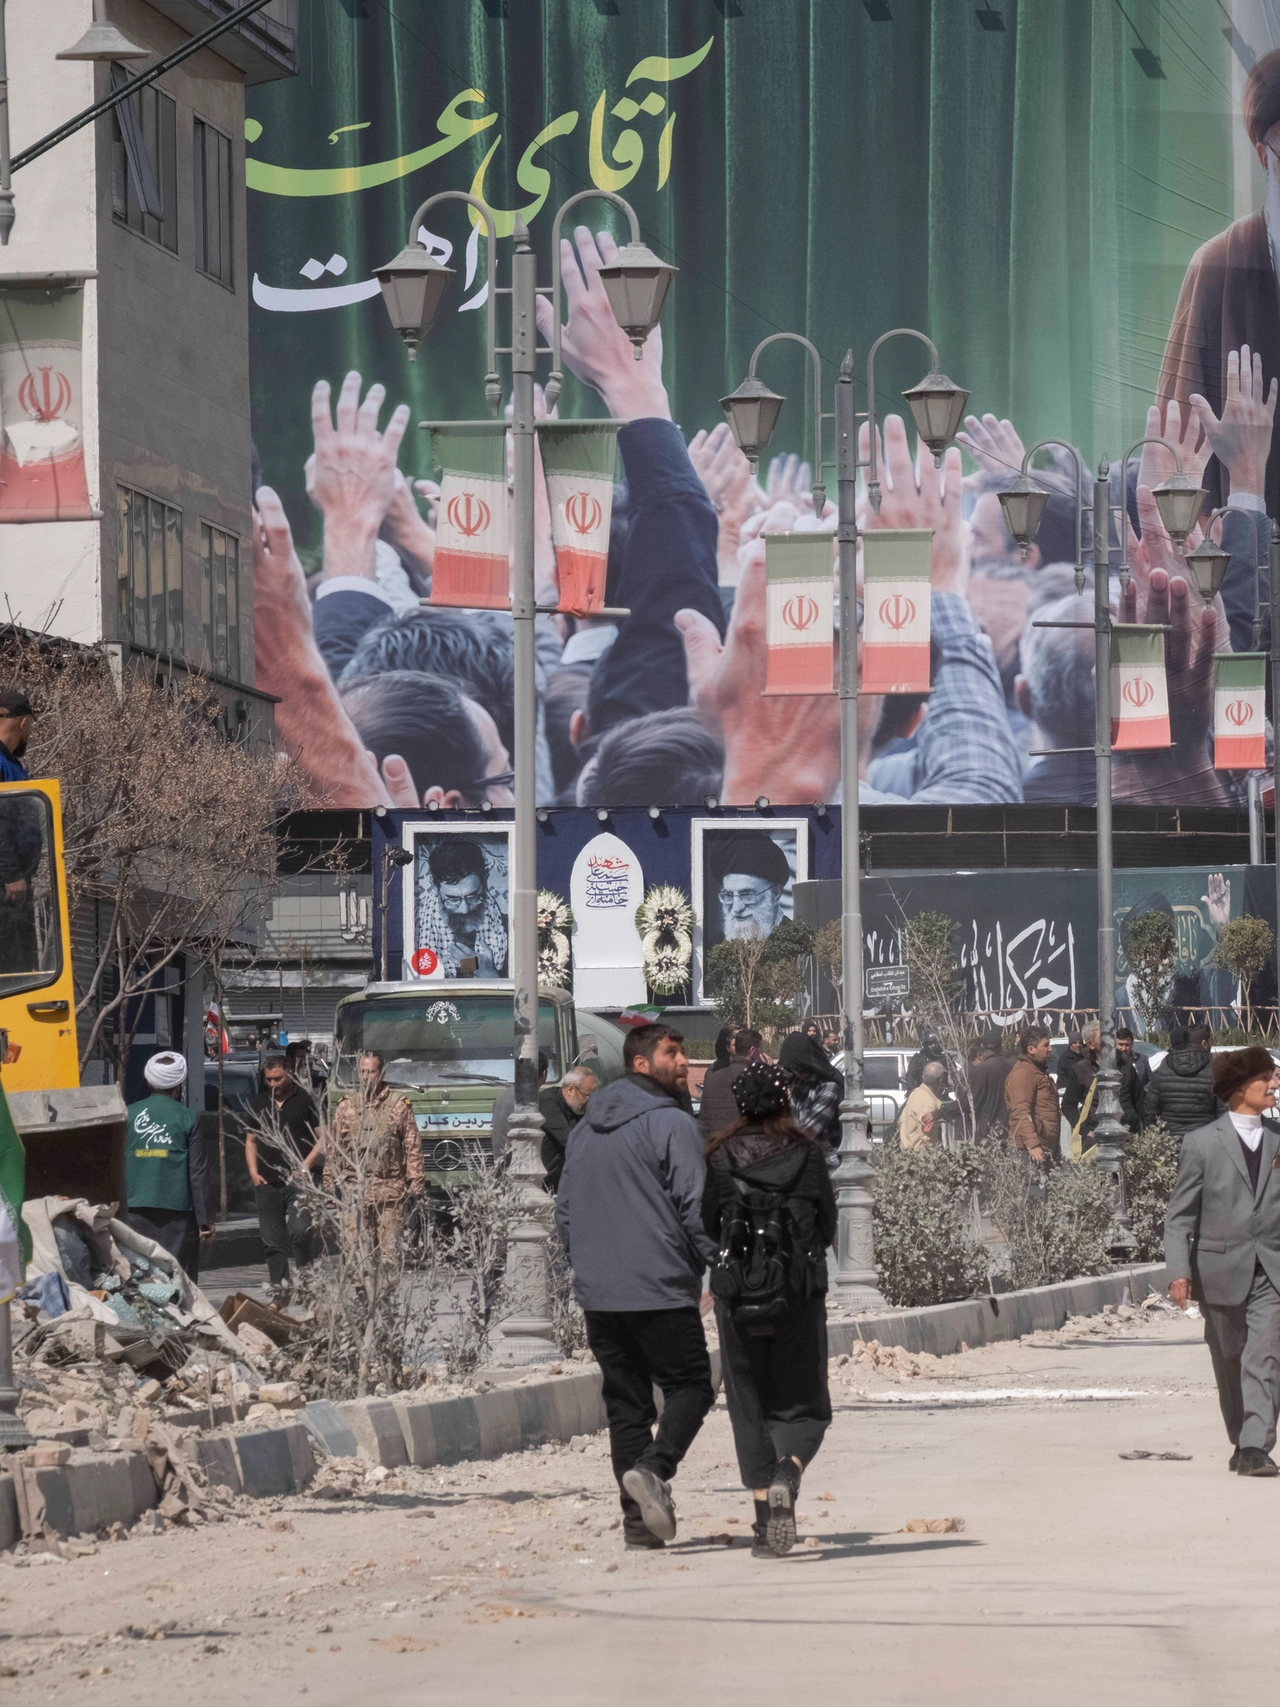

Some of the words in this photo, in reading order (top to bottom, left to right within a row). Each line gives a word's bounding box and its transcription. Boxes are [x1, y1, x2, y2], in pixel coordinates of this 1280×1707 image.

[466, 35, 714, 238] آقای
[587, 855, 629, 869] شهید
[420, 1115, 449, 1129] کار
